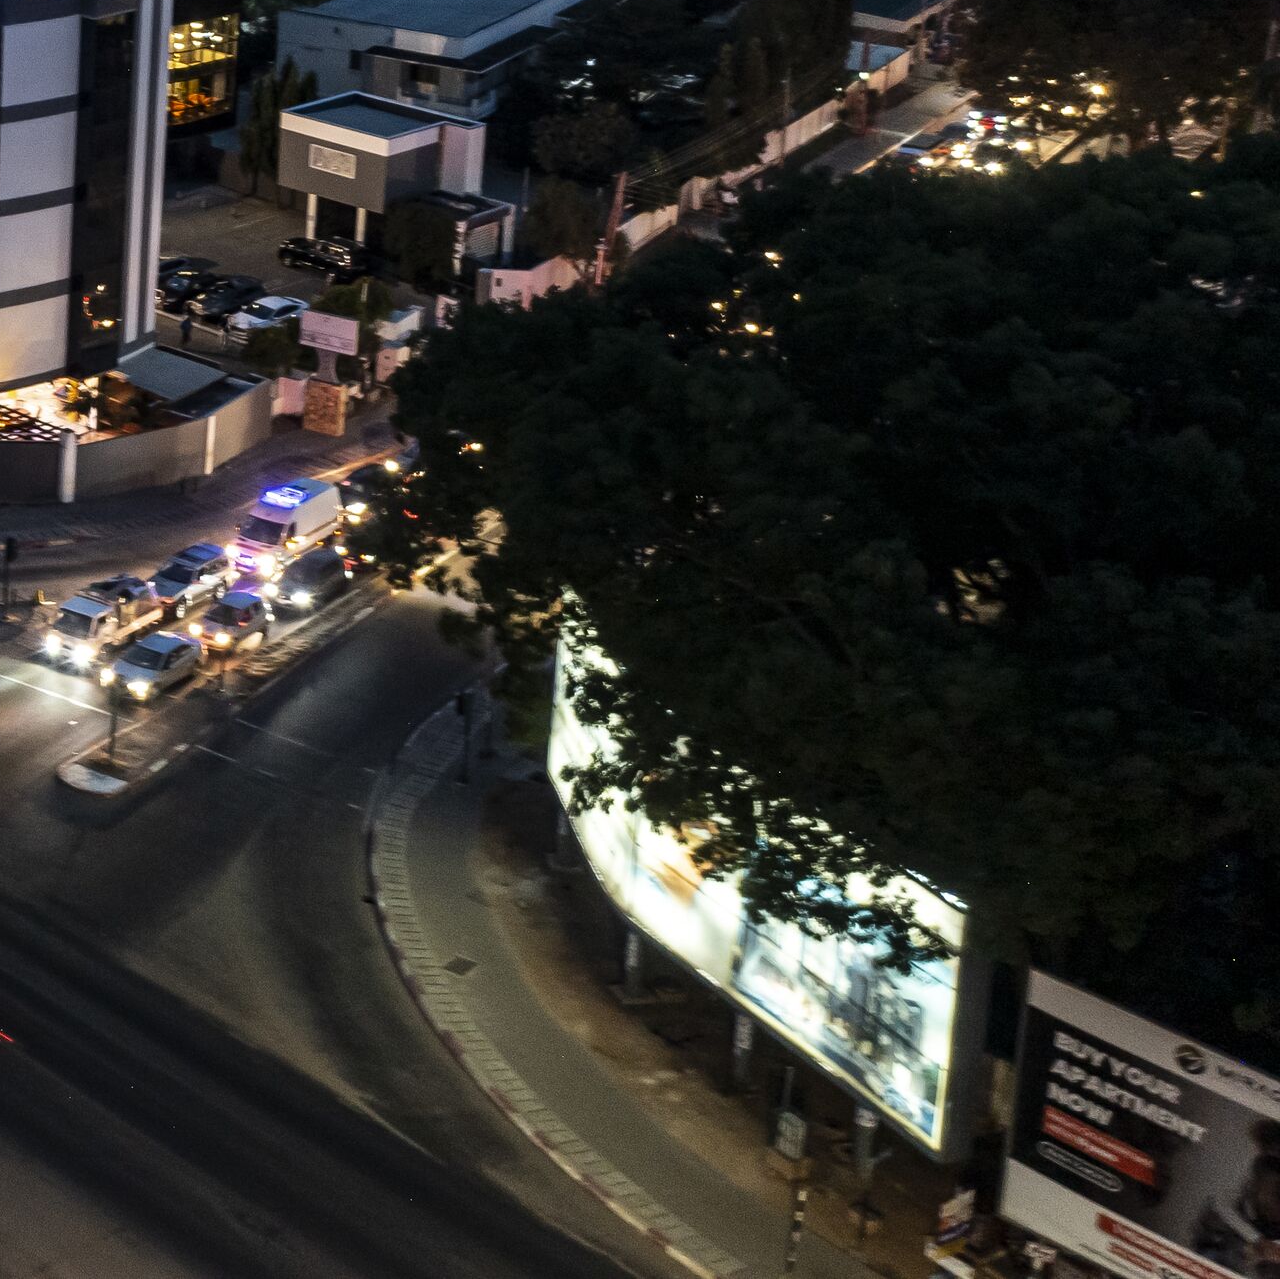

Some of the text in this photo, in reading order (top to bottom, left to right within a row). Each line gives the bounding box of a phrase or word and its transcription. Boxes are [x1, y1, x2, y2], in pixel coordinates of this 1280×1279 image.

[1046, 1082, 1114, 1126] NOW
[1050, 1059, 1208, 1142] APARTMENT
[1108, 1058, 1183, 1104] YOUR
